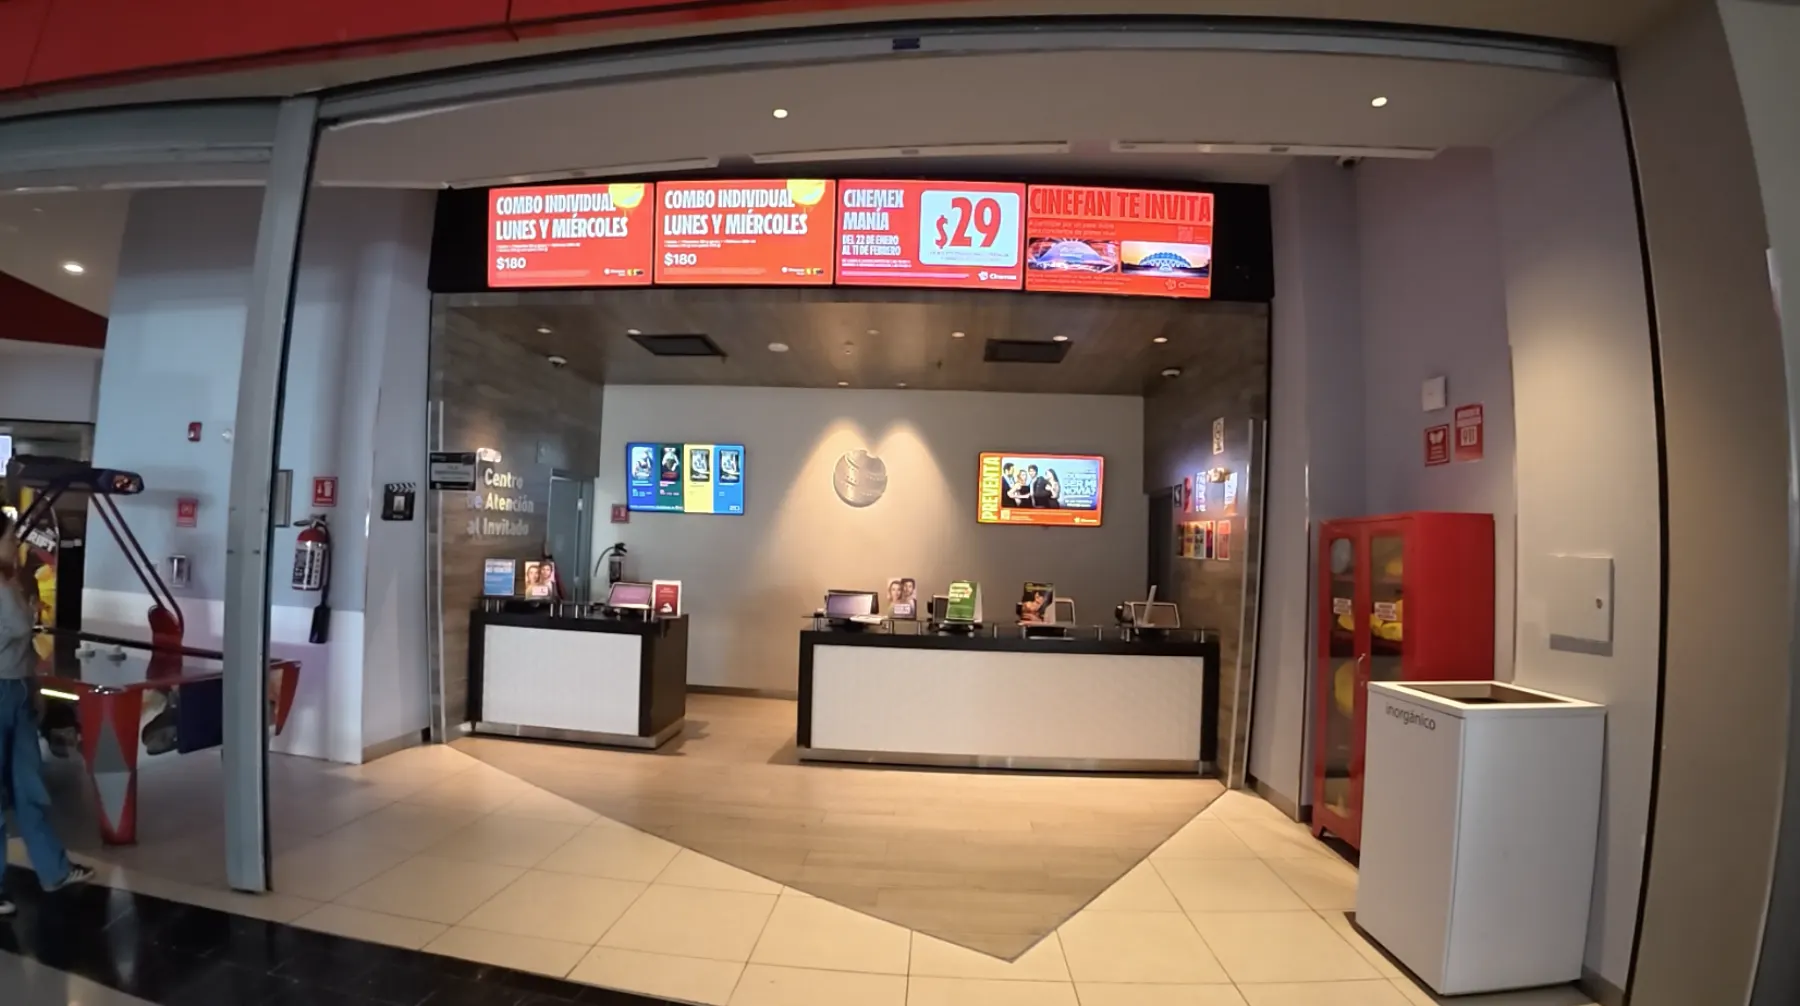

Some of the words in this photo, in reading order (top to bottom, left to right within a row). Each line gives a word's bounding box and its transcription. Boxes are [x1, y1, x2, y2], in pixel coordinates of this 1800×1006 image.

[496, 196, 543, 215] COMBO
[545, 193, 616, 213] INDIVIDUAL
[664, 190, 715, 209] COMBO
[718, 188, 795, 208] INDIVIDUAL
[843, 189, 904, 208] CINEMEX
[1030, 188, 1111, 217] CINEFAN
[1117, 192, 1140, 218] TE
[1145, 193, 1211, 222] INVITA
[496, 219, 536, 240] LUNES
[539, 218, 549, 239] Y
[552, 213, 628, 238] MIÉRCOLES
[663, 214, 708, 235] LUNES
[711, 214, 723, 235] Y
[725, 209, 808, 235] MIÉRCOLES
[843, 207, 889, 231] MANÍA
[935, 196, 1002, 249] $29
[842, 234, 855, 245] DEL
[856, 235, 865, 245] 22
[866, 235, 876, 245] DE
[876, 235, 899, 245] ENERO
[842, 245, 852, 255] AL
[860, 245, 869, 255] DE
[870, 245, 901, 256] FEBRERO
[496, 256, 527, 271] $180
[664, 253, 697, 266] $180
[484, 467, 523, 489] Centro
[981, 457, 1001, 521] PREVENTA
[485, 492, 534, 513] Atención
[483, 517, 529, 536] Invitado
[1386, 701, 1436, 730] inorgánico
